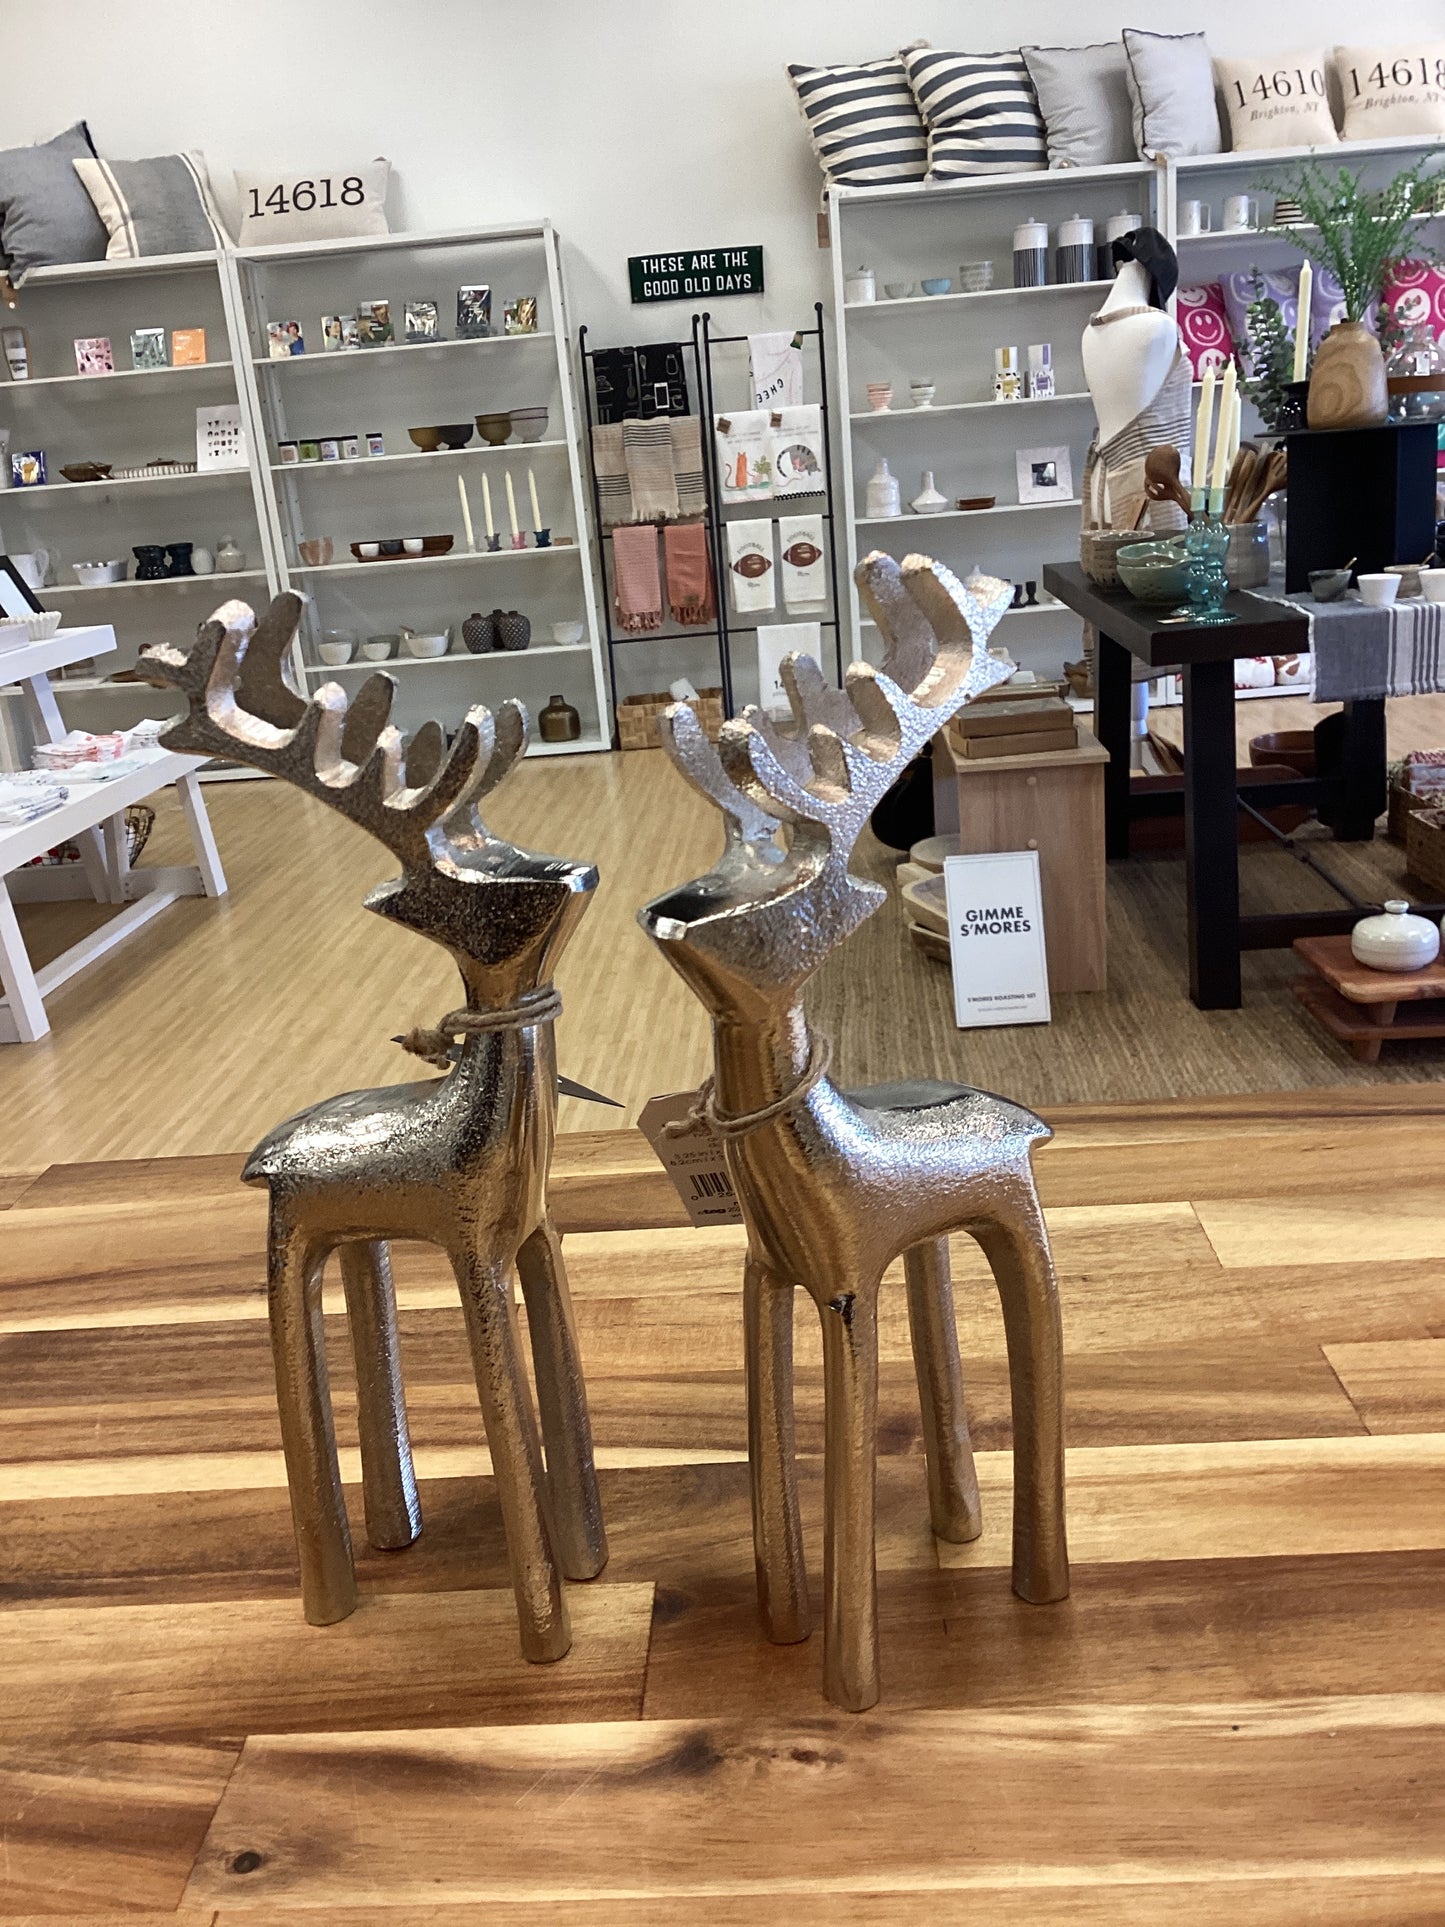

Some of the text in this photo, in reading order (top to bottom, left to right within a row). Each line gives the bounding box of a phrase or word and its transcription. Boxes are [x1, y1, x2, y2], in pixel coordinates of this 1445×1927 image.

[1233, 70, 1326, 110] 14610
[1364, 93, 1419, 110] Brighton,
[1249, 104, 1300, 121] Brighton,
[249, 176, 365, 218] 14618
[641, 251, 749, 274] THESE ARE THE
[643, 273, 752, 297] GOOD OLD DAYS
[966, 906, 1024, 923] GIMME
[960, 919, 1032, 937] S'MORES
